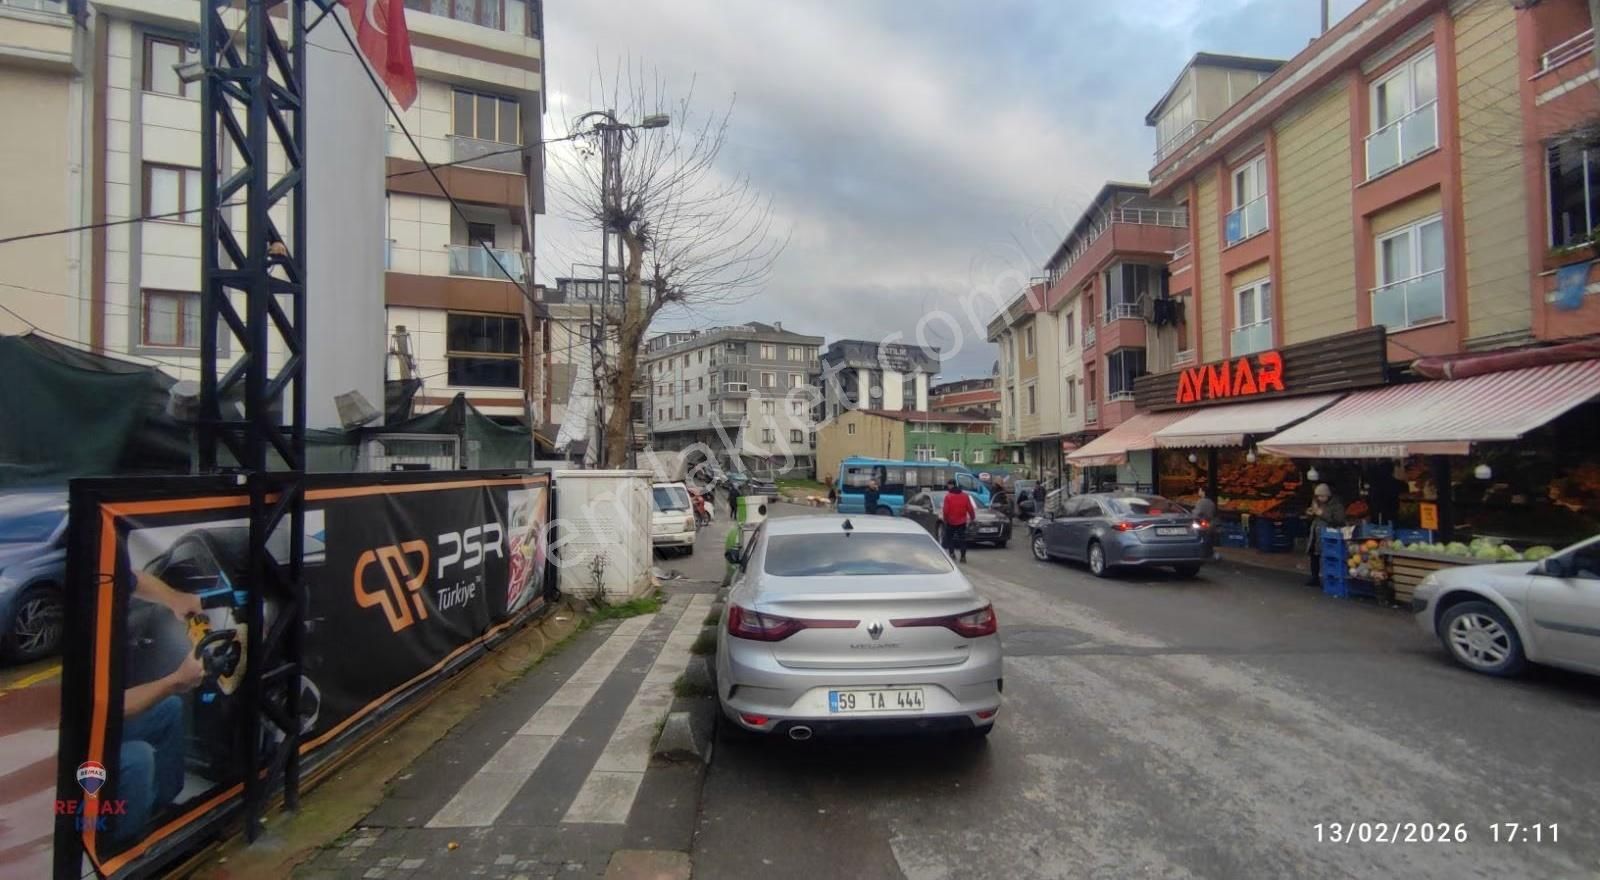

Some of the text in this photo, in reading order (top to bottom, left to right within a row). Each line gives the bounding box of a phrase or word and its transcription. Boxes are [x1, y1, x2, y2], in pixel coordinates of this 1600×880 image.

[1176, 351, 1285, 404] AYMAR
[1360, 445, 1406, 456] MARKET
[438, 522, 504, 579] PSR
[437, 580, 477, 611] Türkiye
[839, 691, 922, 709] 59 TA 444
